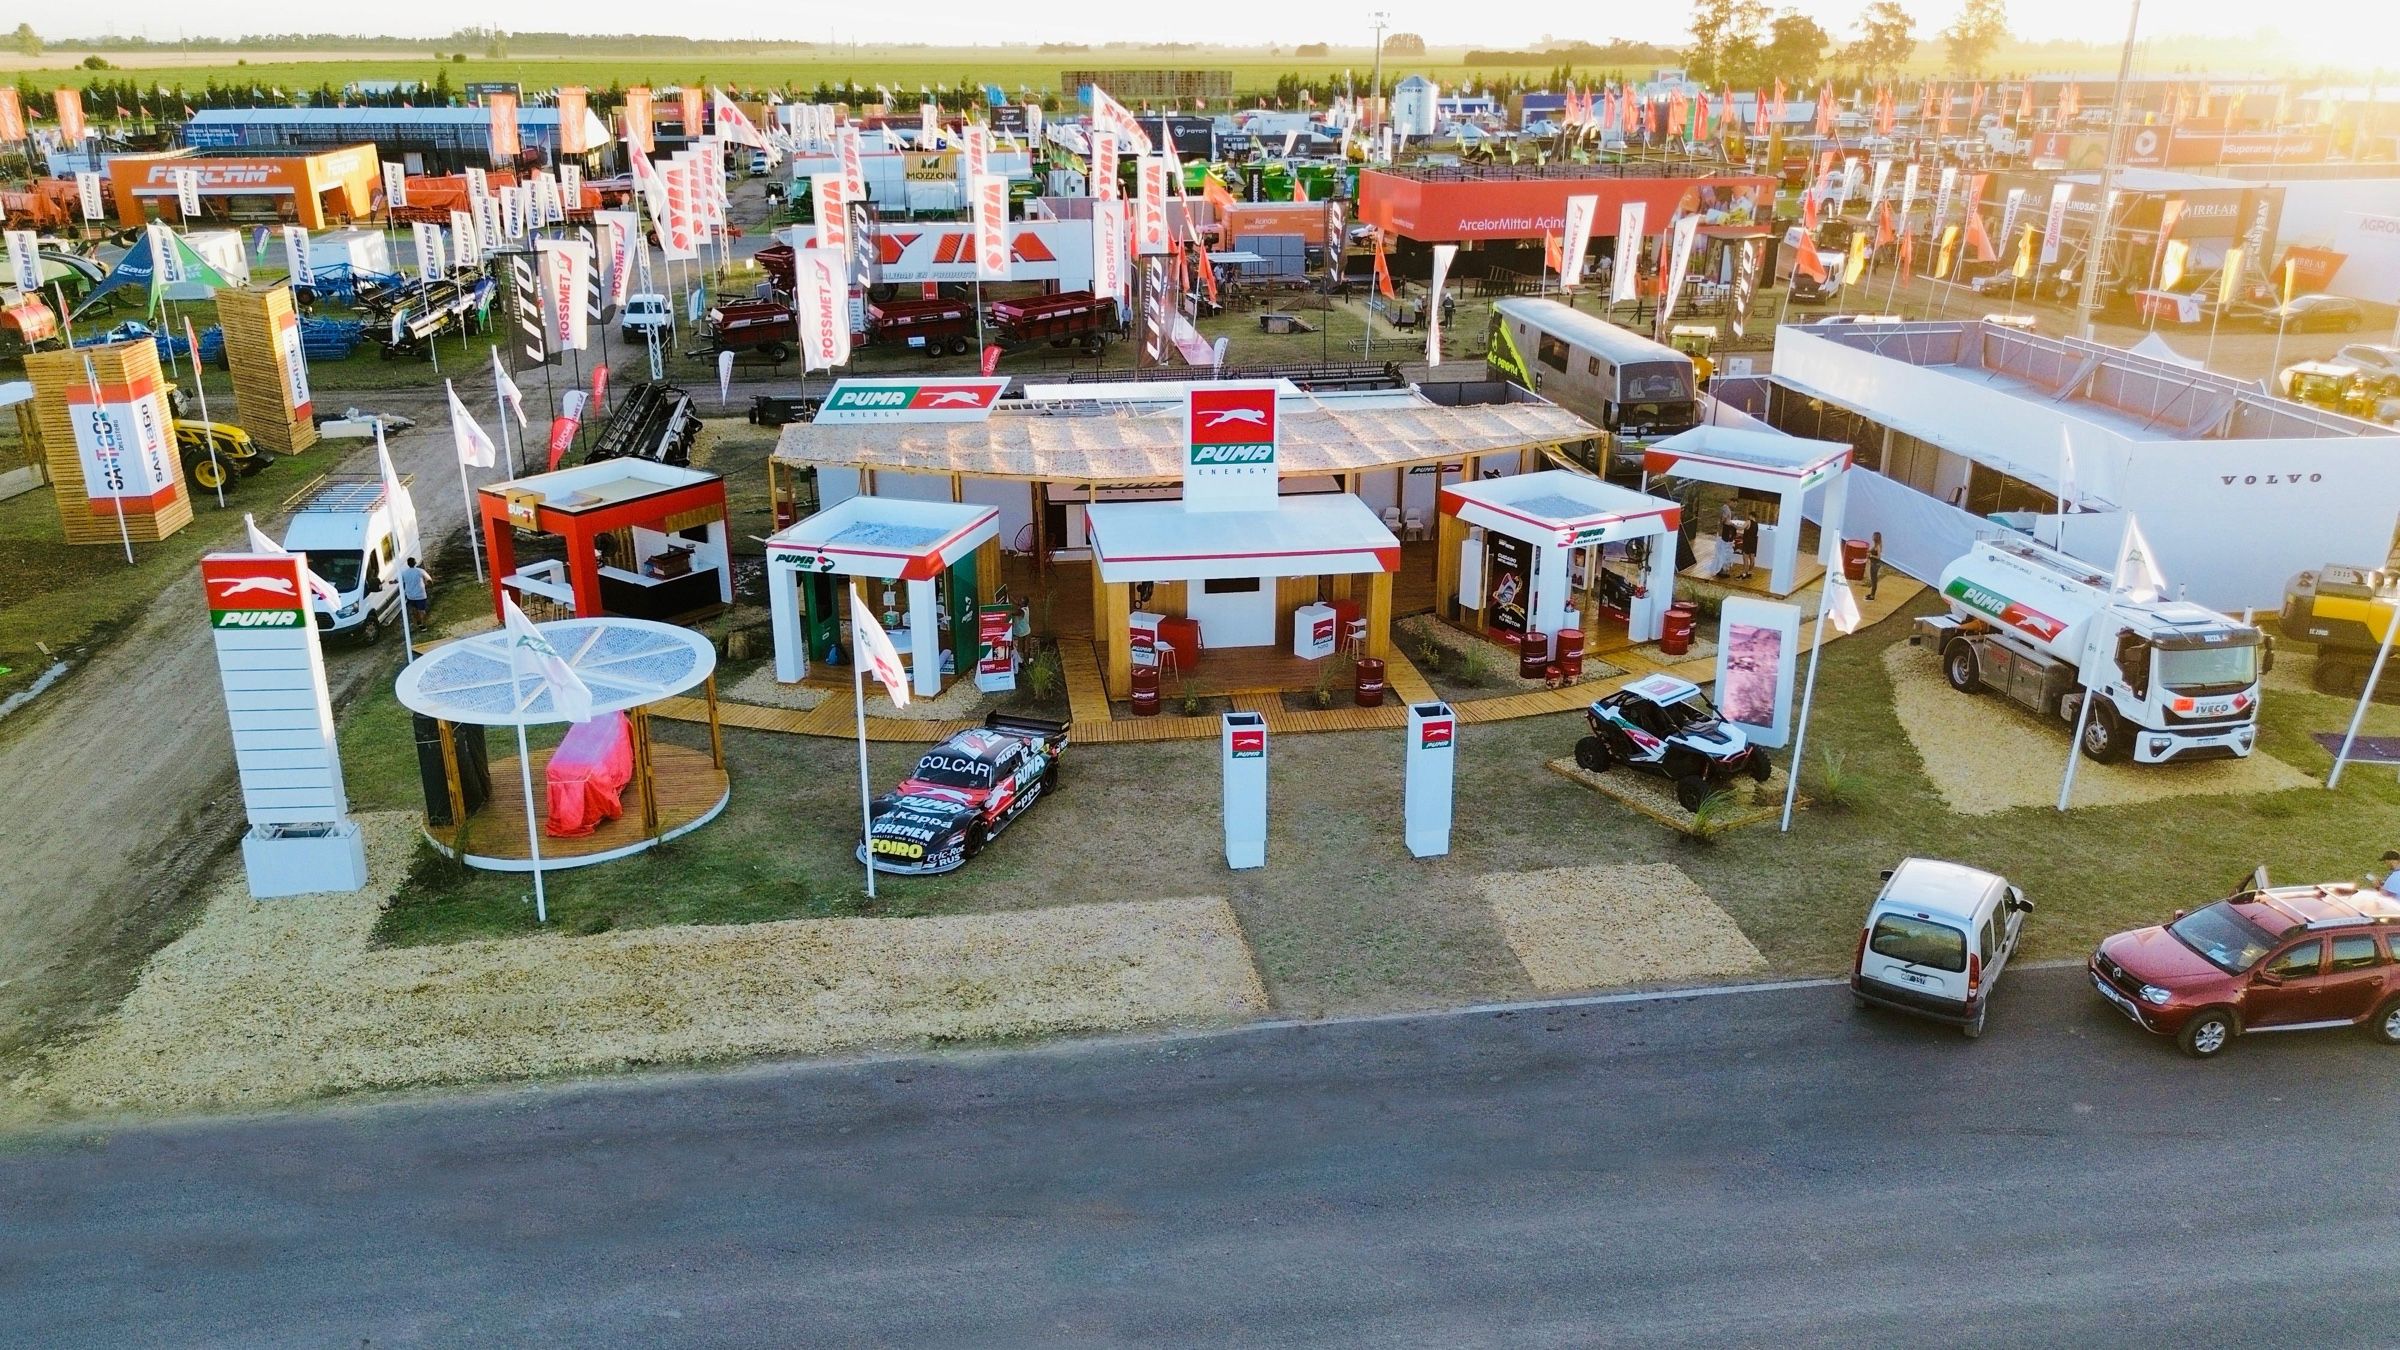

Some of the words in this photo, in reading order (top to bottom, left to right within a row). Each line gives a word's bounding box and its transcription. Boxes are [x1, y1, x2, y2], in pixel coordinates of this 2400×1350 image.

[906, 172, 957, 180] MOZZONI
[822, 181, 844, 249] YRA
[1458, 217, 1532, 231] ArcelorMittal
[16, 233, 38, 290] Gauss
[423, 225, 438, 280] Gauss
[611, 241, 625, 298] ROSSMET
[512, 253, 545, 362] LITO
[558, 274, 571, 341] ROSSMET
[1145, 255, 1163, 362] LITO
[820, 285, 833, 359] ROSSMET
[836, 391, 908, 406] PUMA
[839, 411, 902, 419] ENERGY
[1192, 446, 1275, 464] PUMA
[1198, 468, 1268, 476] ENERGY
[2220, 472, 2323, 486] VOLVO
[774, 553, 816, 565] PUMA
[1962, 587, 2006, 615] PUMA
[219, 611, 298, 627] PUMA
[2195, 703, 2229, 714] IVECO
[1426, 740, 1449, 749] PUMA
[995, 741, 1023, 768] PARDO
[919, 755, 990, 778] COLCAR
[1015, 753, 1046, 791] PUMA
[900, 795, 966, 815] PUMA
[895, 811, 953, 829] Kappa
[871, 823, 936, 842] BREMEN
[871, 838, 923, 859] COIRO
[939, 854, 961, 866] RUS
